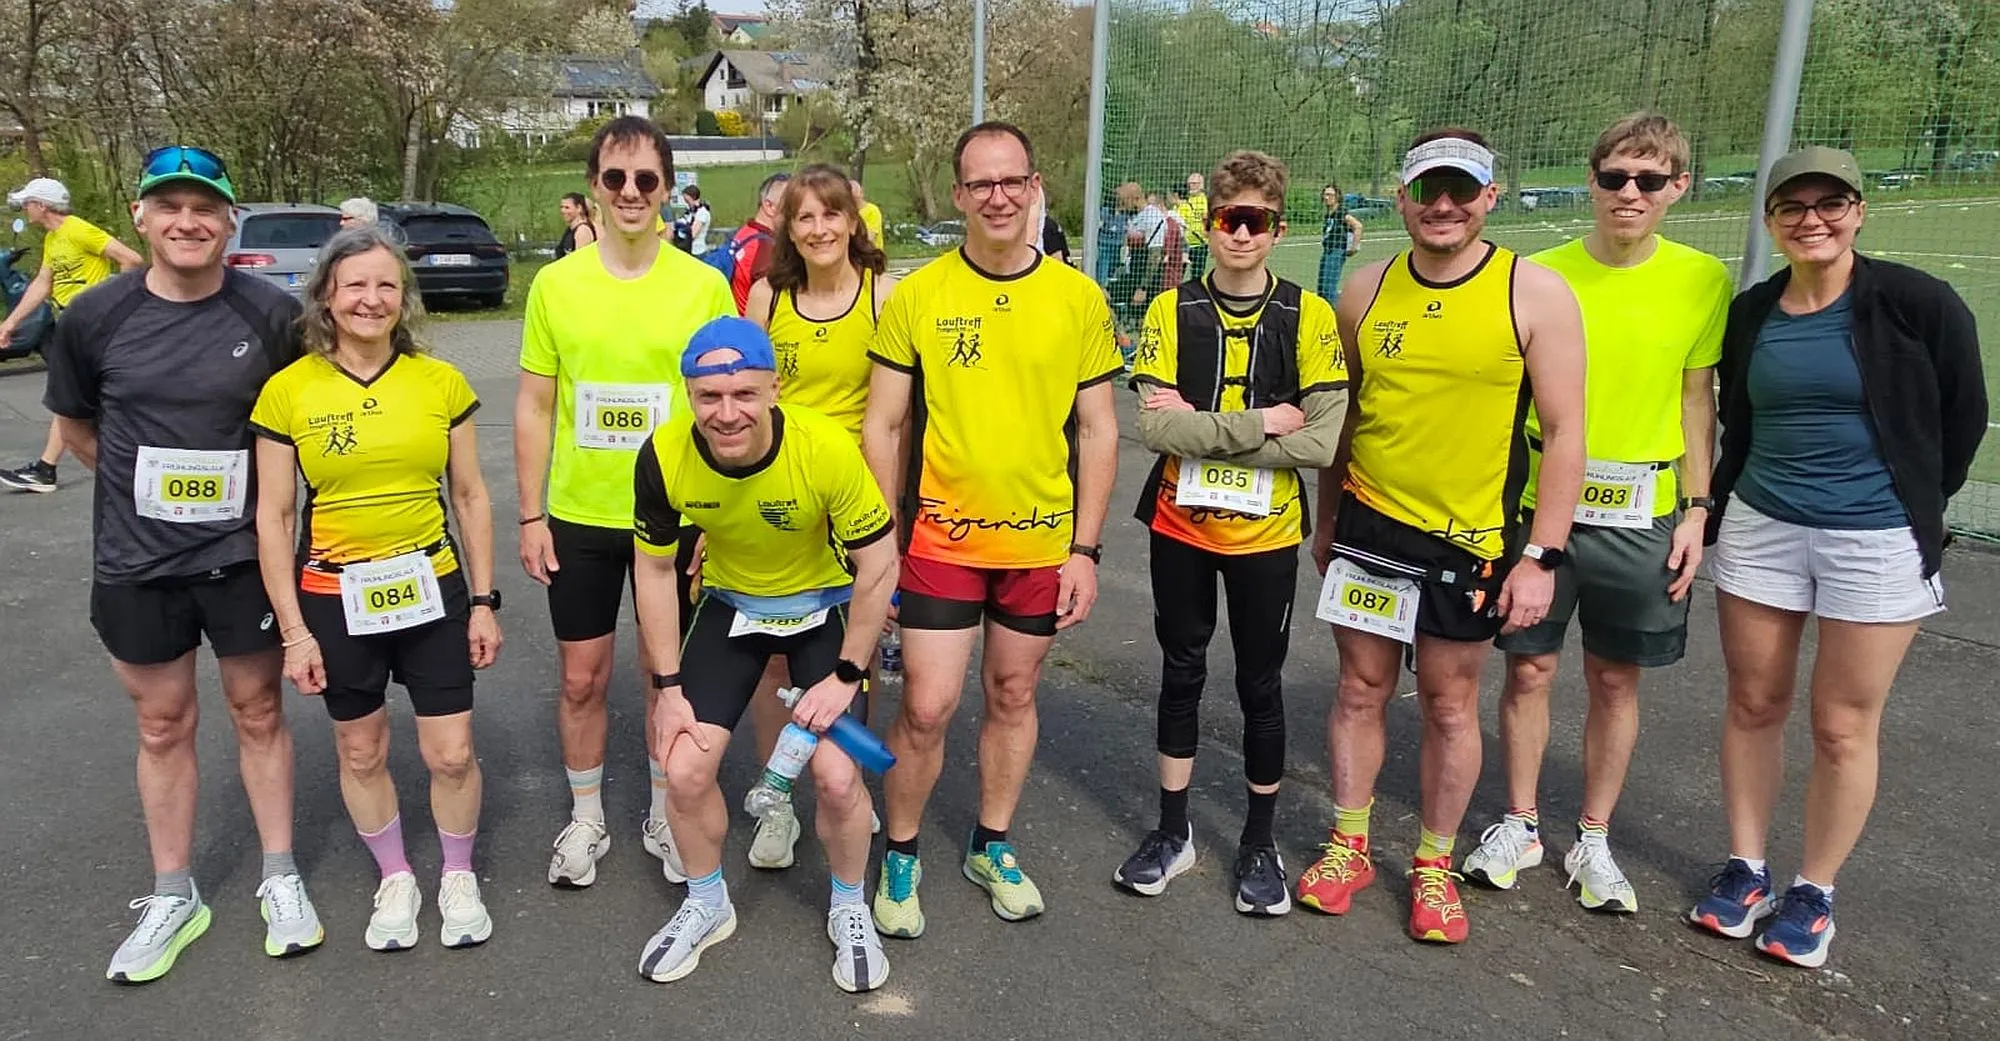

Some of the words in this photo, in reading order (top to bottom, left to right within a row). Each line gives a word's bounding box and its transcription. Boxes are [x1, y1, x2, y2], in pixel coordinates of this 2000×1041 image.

[936, 317, 984, 329] Lauftreff
[308, 411, 354, 425] Lauftreff
[602, 411, 643, 428] 086
[1206, 468, 1249, 488] 085
[168, 479, 217, 498] 088
[1584, 486, 1627, 505] 083
[370, 583, 415, 608] 084
[1348, 588, 1391, 612] 087
